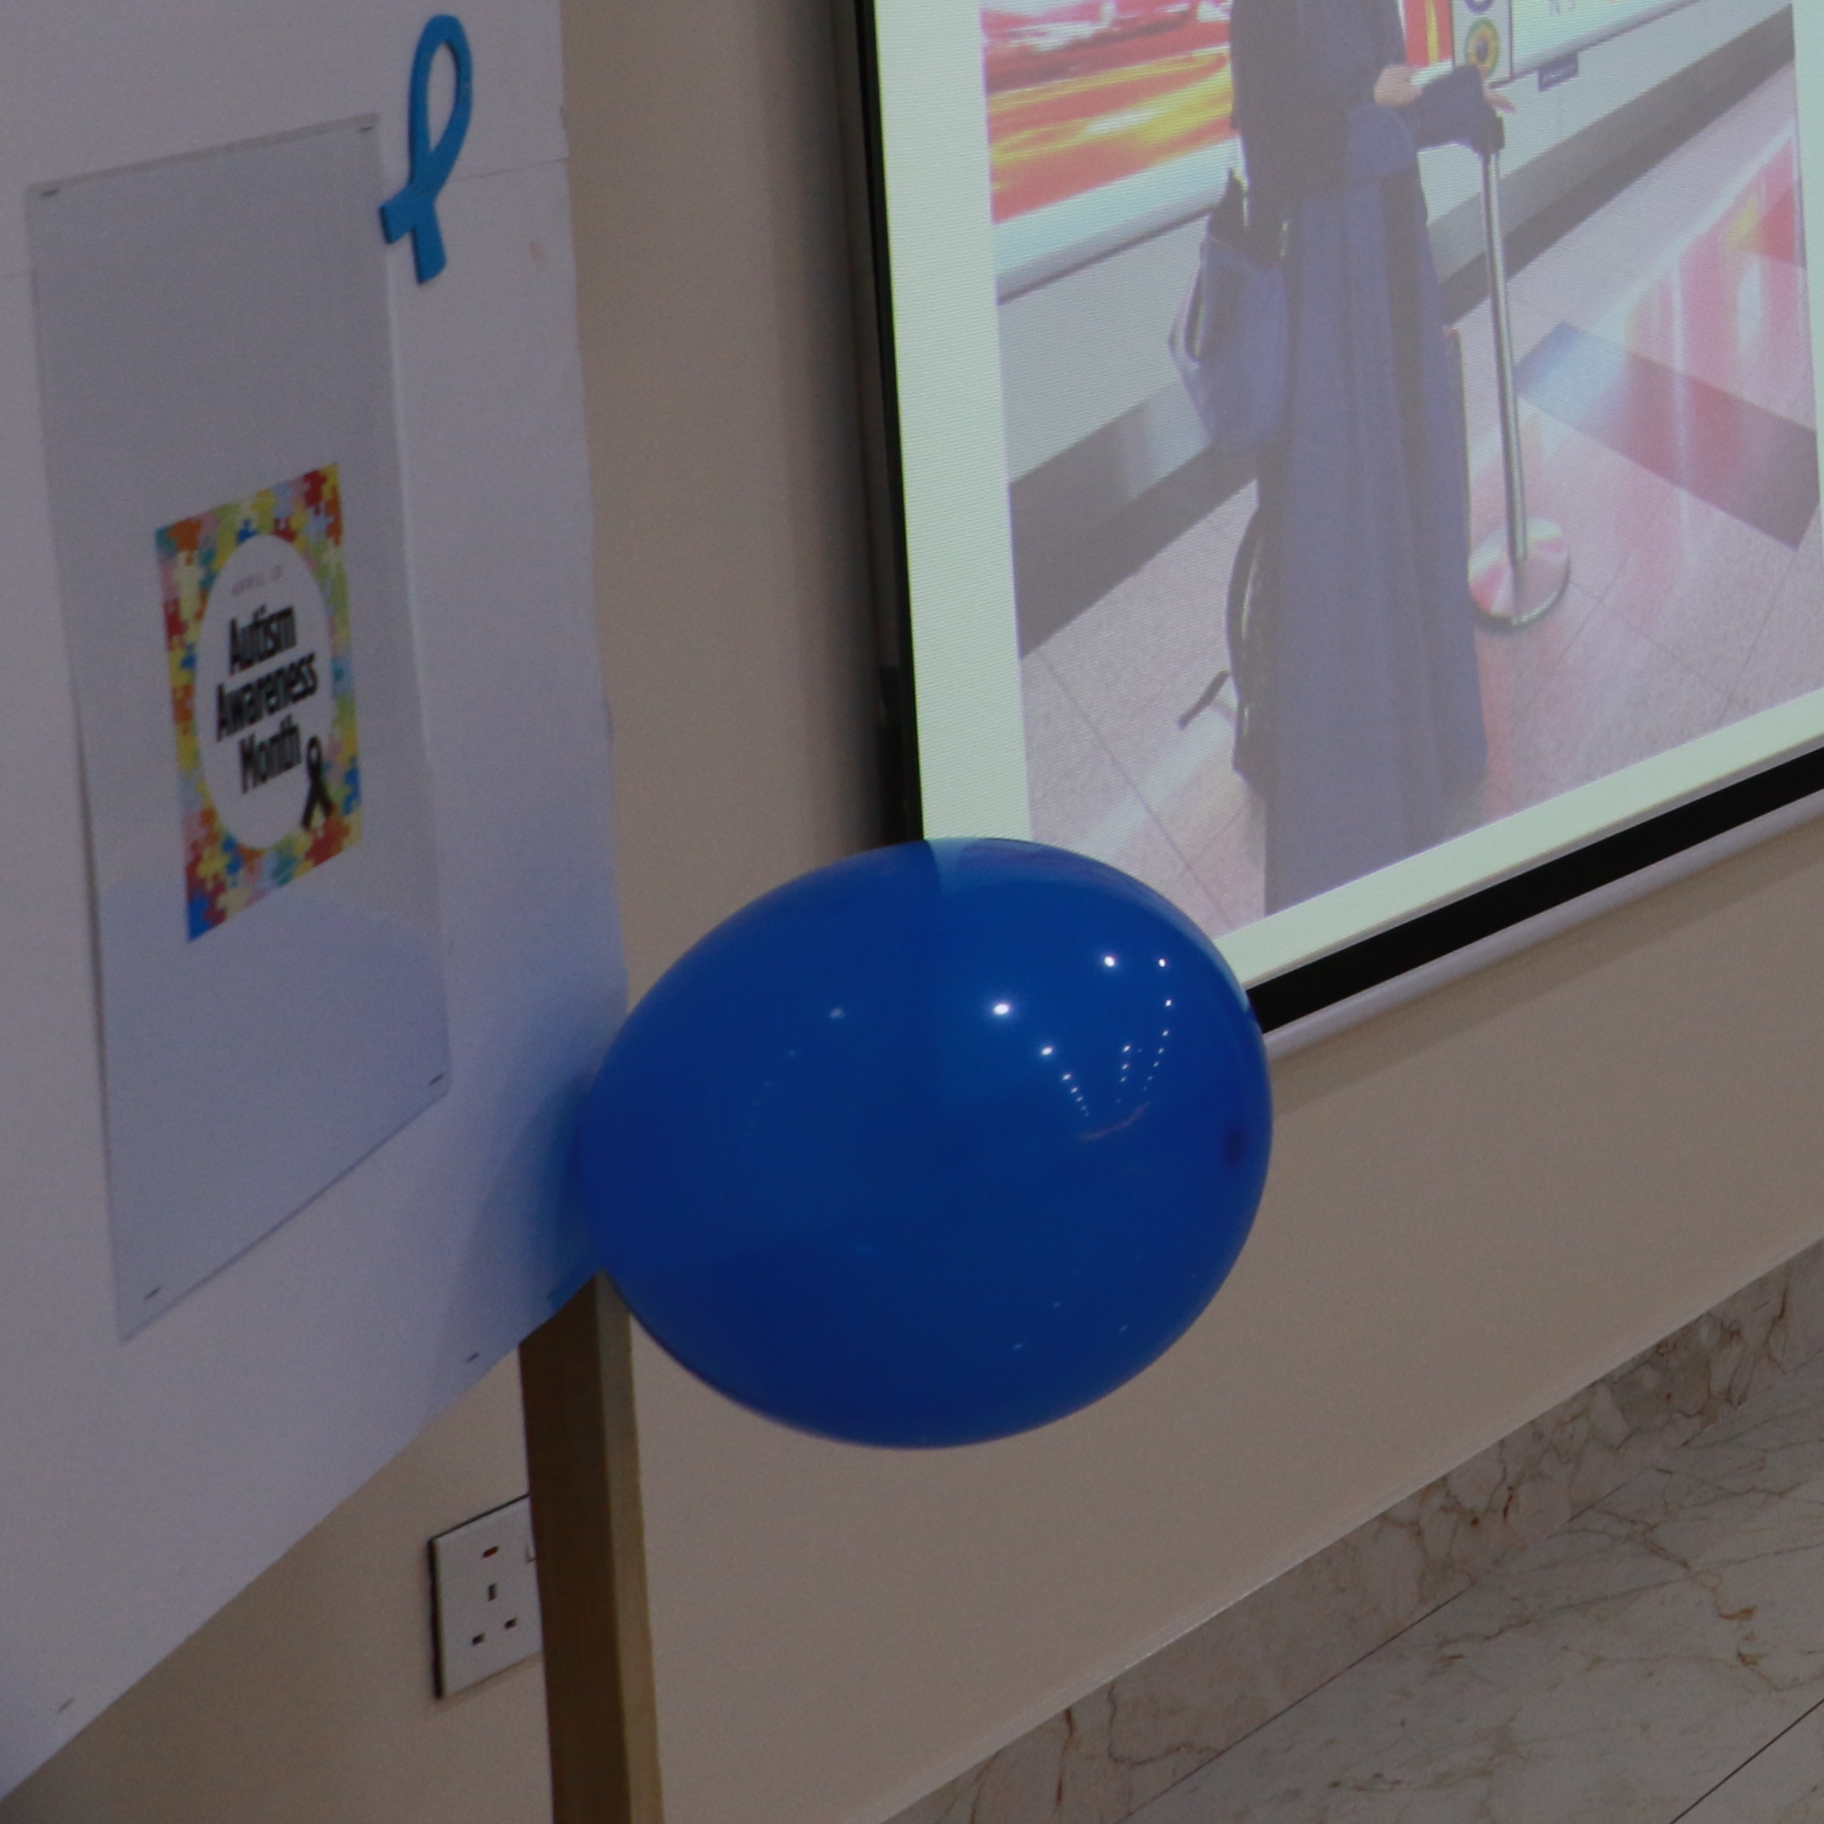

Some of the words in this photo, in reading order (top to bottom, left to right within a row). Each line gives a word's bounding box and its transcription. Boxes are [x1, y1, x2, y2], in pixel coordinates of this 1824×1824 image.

[229, 604, 297, 677] Autism
[217, 651, 319, 743] Awareness
[239, 713, 303, 795] Month
